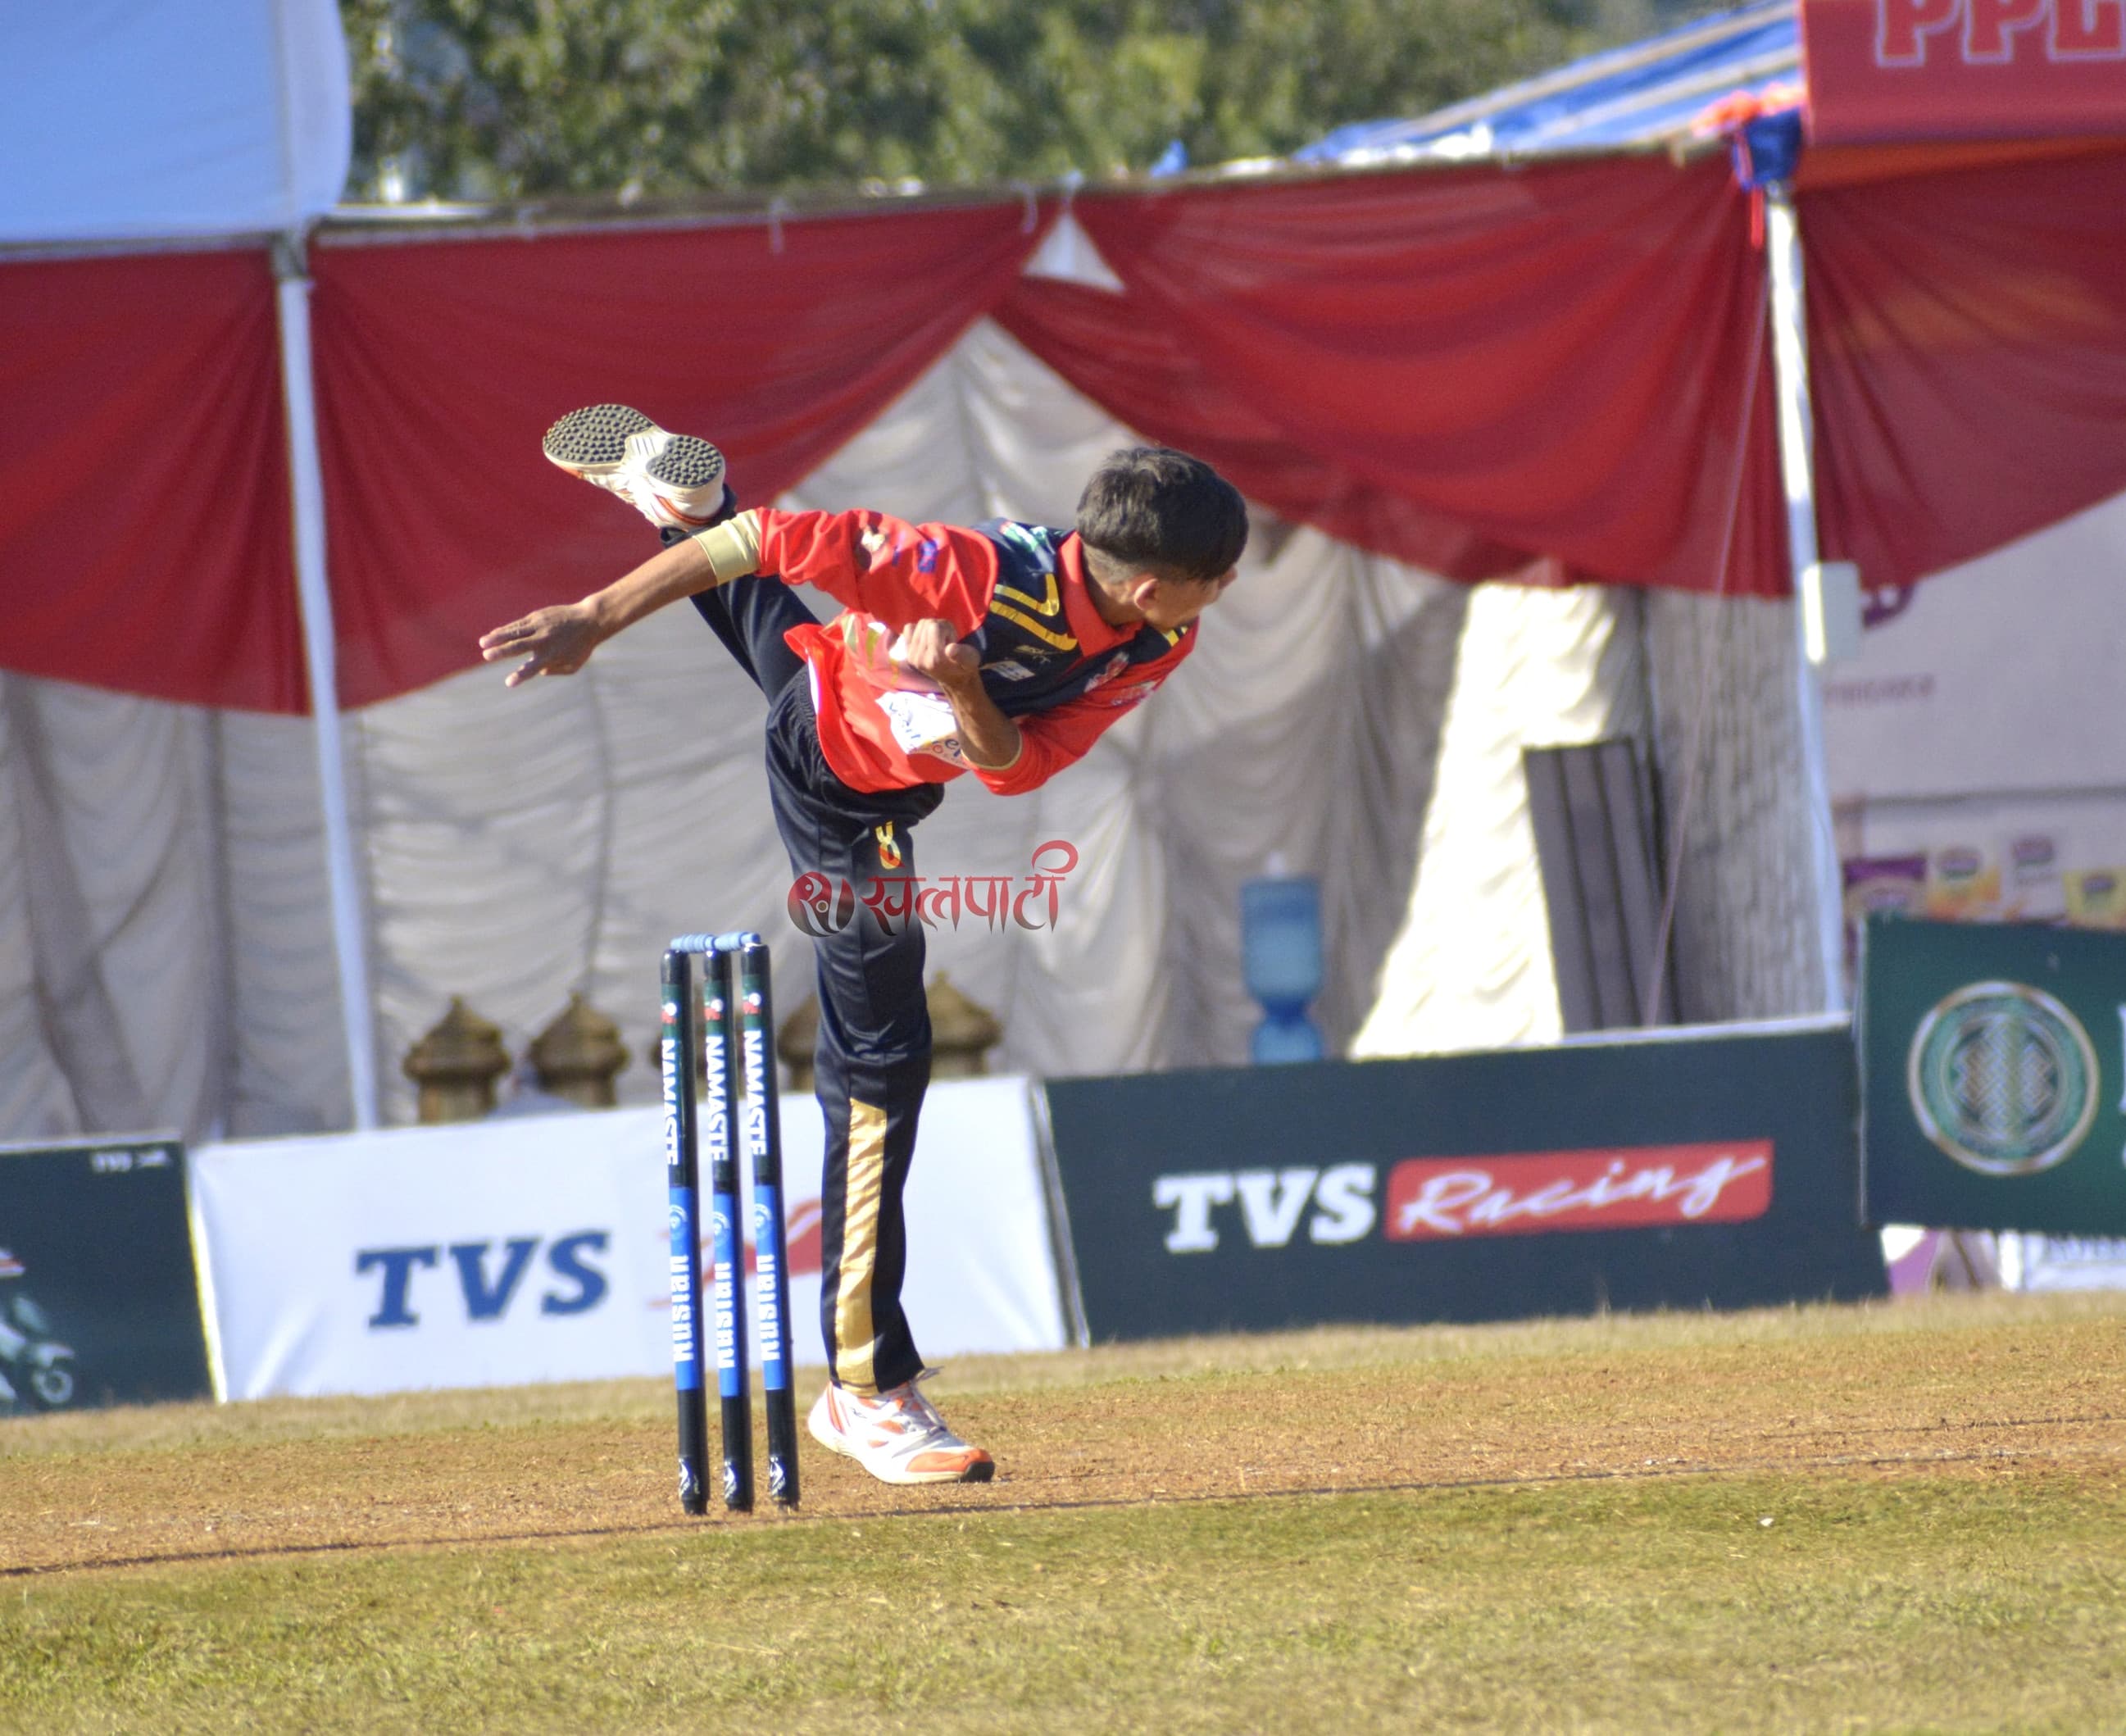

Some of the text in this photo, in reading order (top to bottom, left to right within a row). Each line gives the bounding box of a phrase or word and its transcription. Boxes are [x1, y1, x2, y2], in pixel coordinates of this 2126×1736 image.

[661, 1038, 679, 1166] NAMASTE
[705, 1035, 729, 1161] NAMASTE
[743, 1030, 768, 1156] NAMASTE
[1153, 1156, 1767, 1254] TVS Racing
[356, 1229, 612, 1330] TVS
